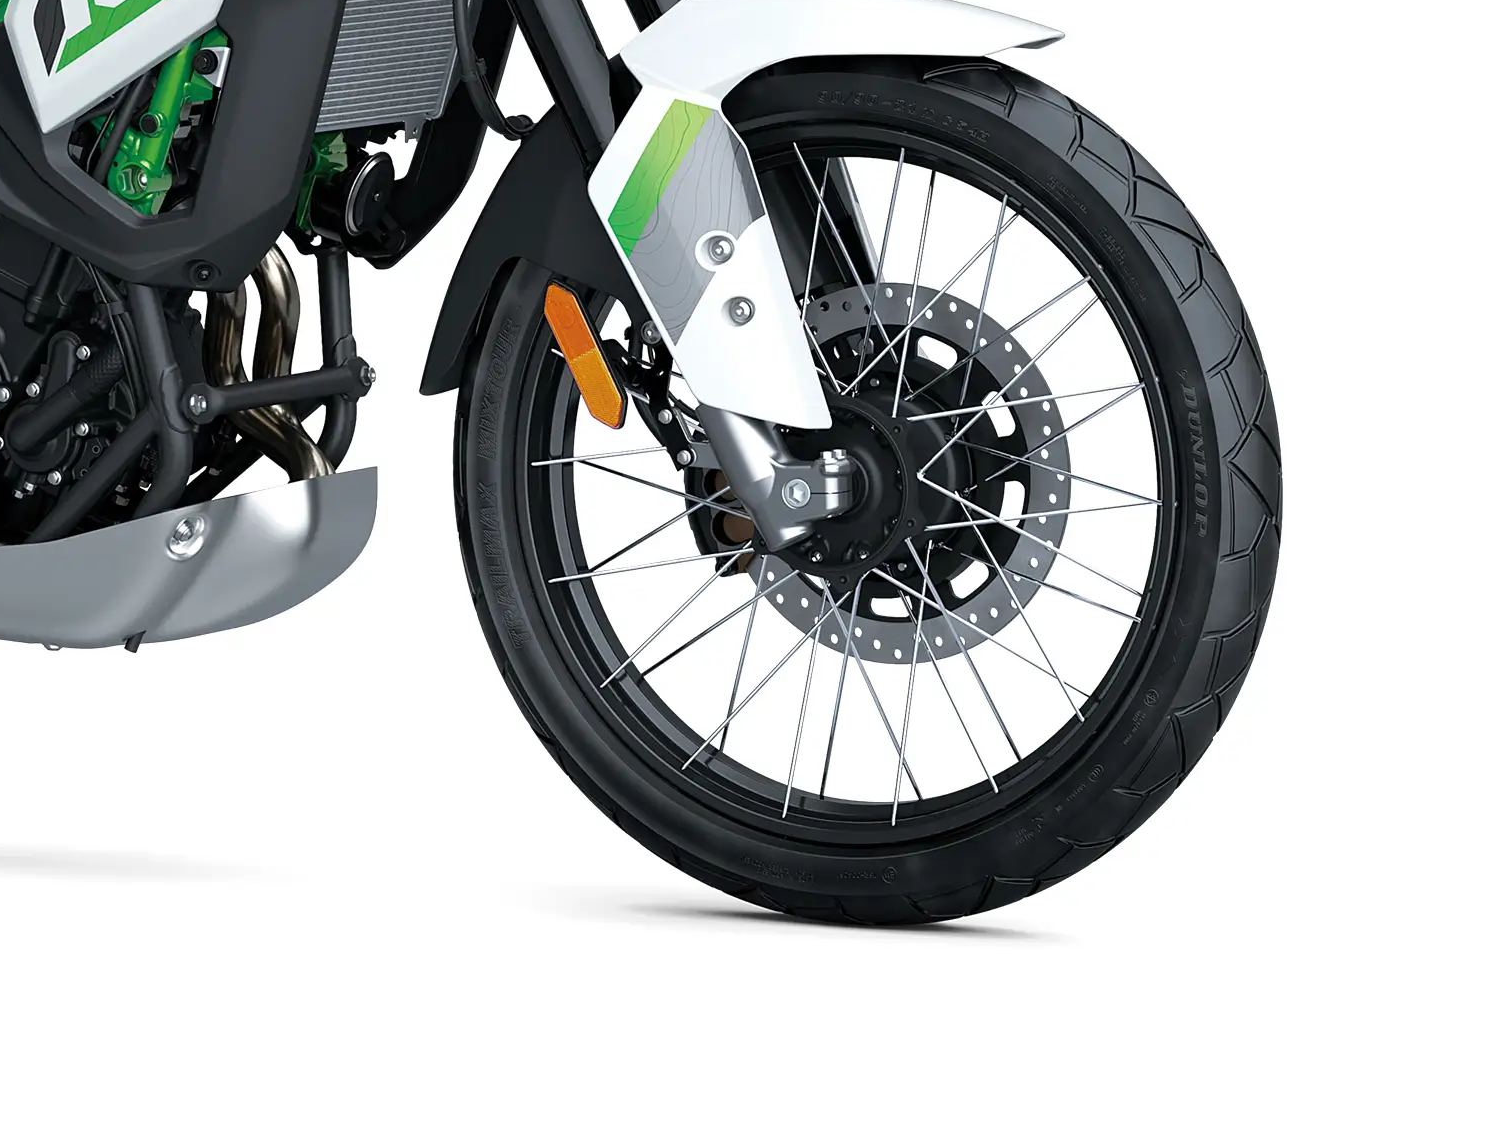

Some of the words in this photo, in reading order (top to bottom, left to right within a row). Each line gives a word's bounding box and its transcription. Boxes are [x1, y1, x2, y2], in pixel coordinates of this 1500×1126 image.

[477, 318, 521, 461] MIXTOUR
[1180, 384, 1209, 538] DUNLOP
[476, 481, 532, 649] TRAILMAX
